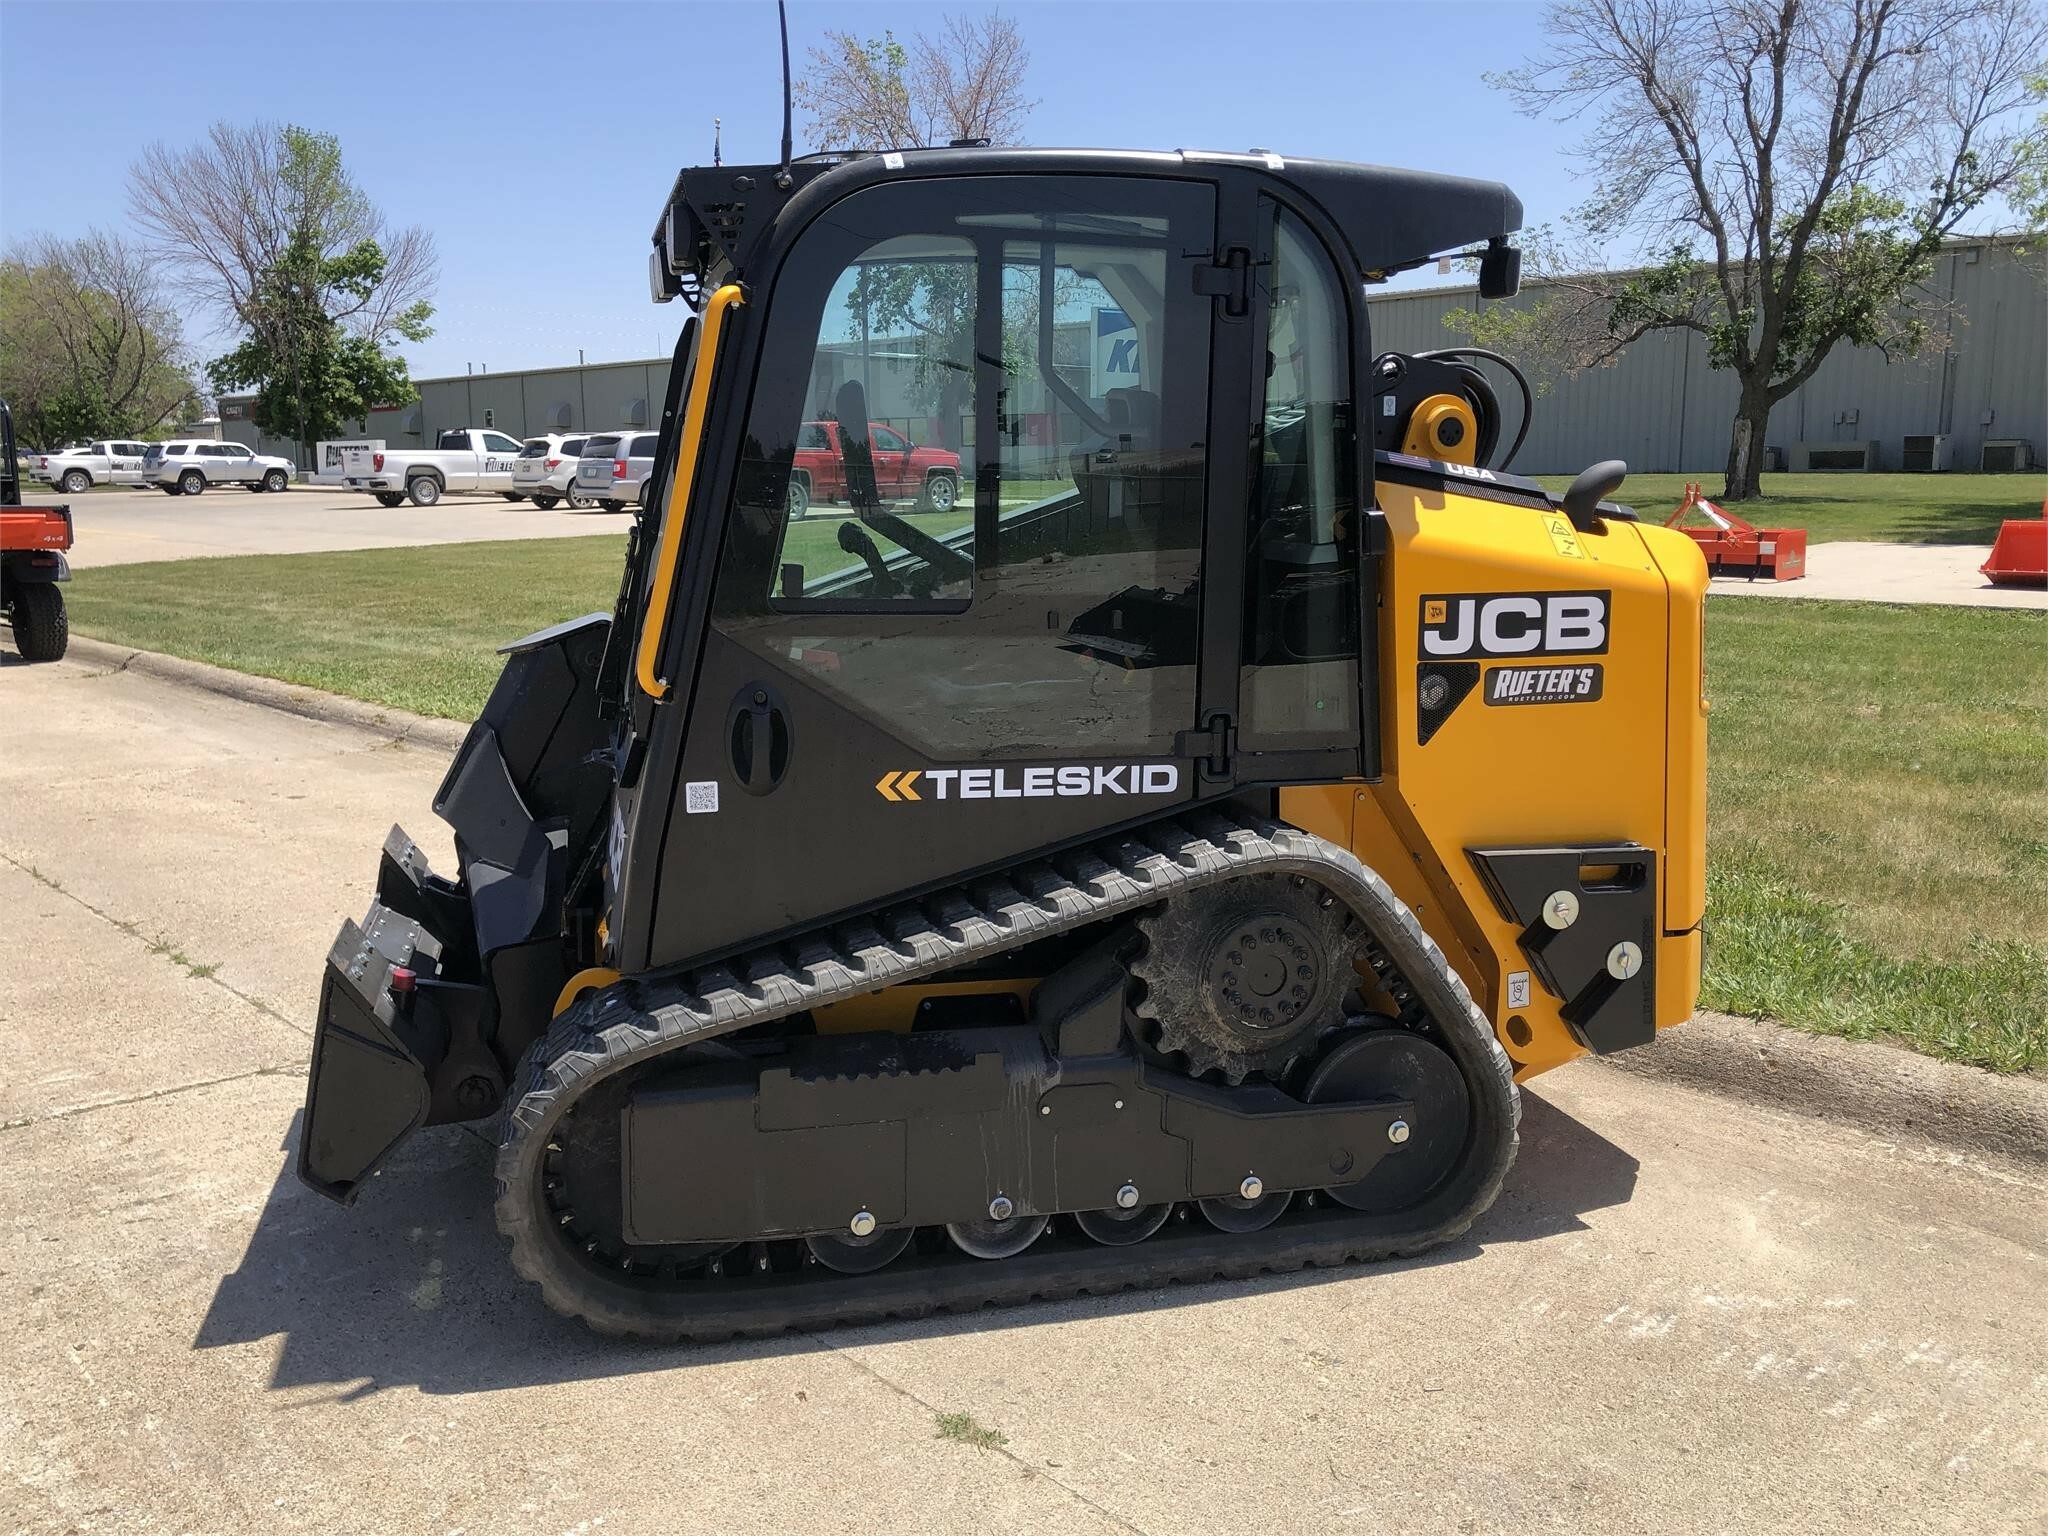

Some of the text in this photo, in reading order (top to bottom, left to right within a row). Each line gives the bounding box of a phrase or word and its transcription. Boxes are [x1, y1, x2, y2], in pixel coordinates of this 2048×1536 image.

[1106, 339, 1140, 373] K
[1446, 462, 1497, 481] USA
[1424, 596, 1606, 655] JCB
[1493, 668, 1595, 700] RUETER'S
[925, 764, 1178, 800] TELESKID
